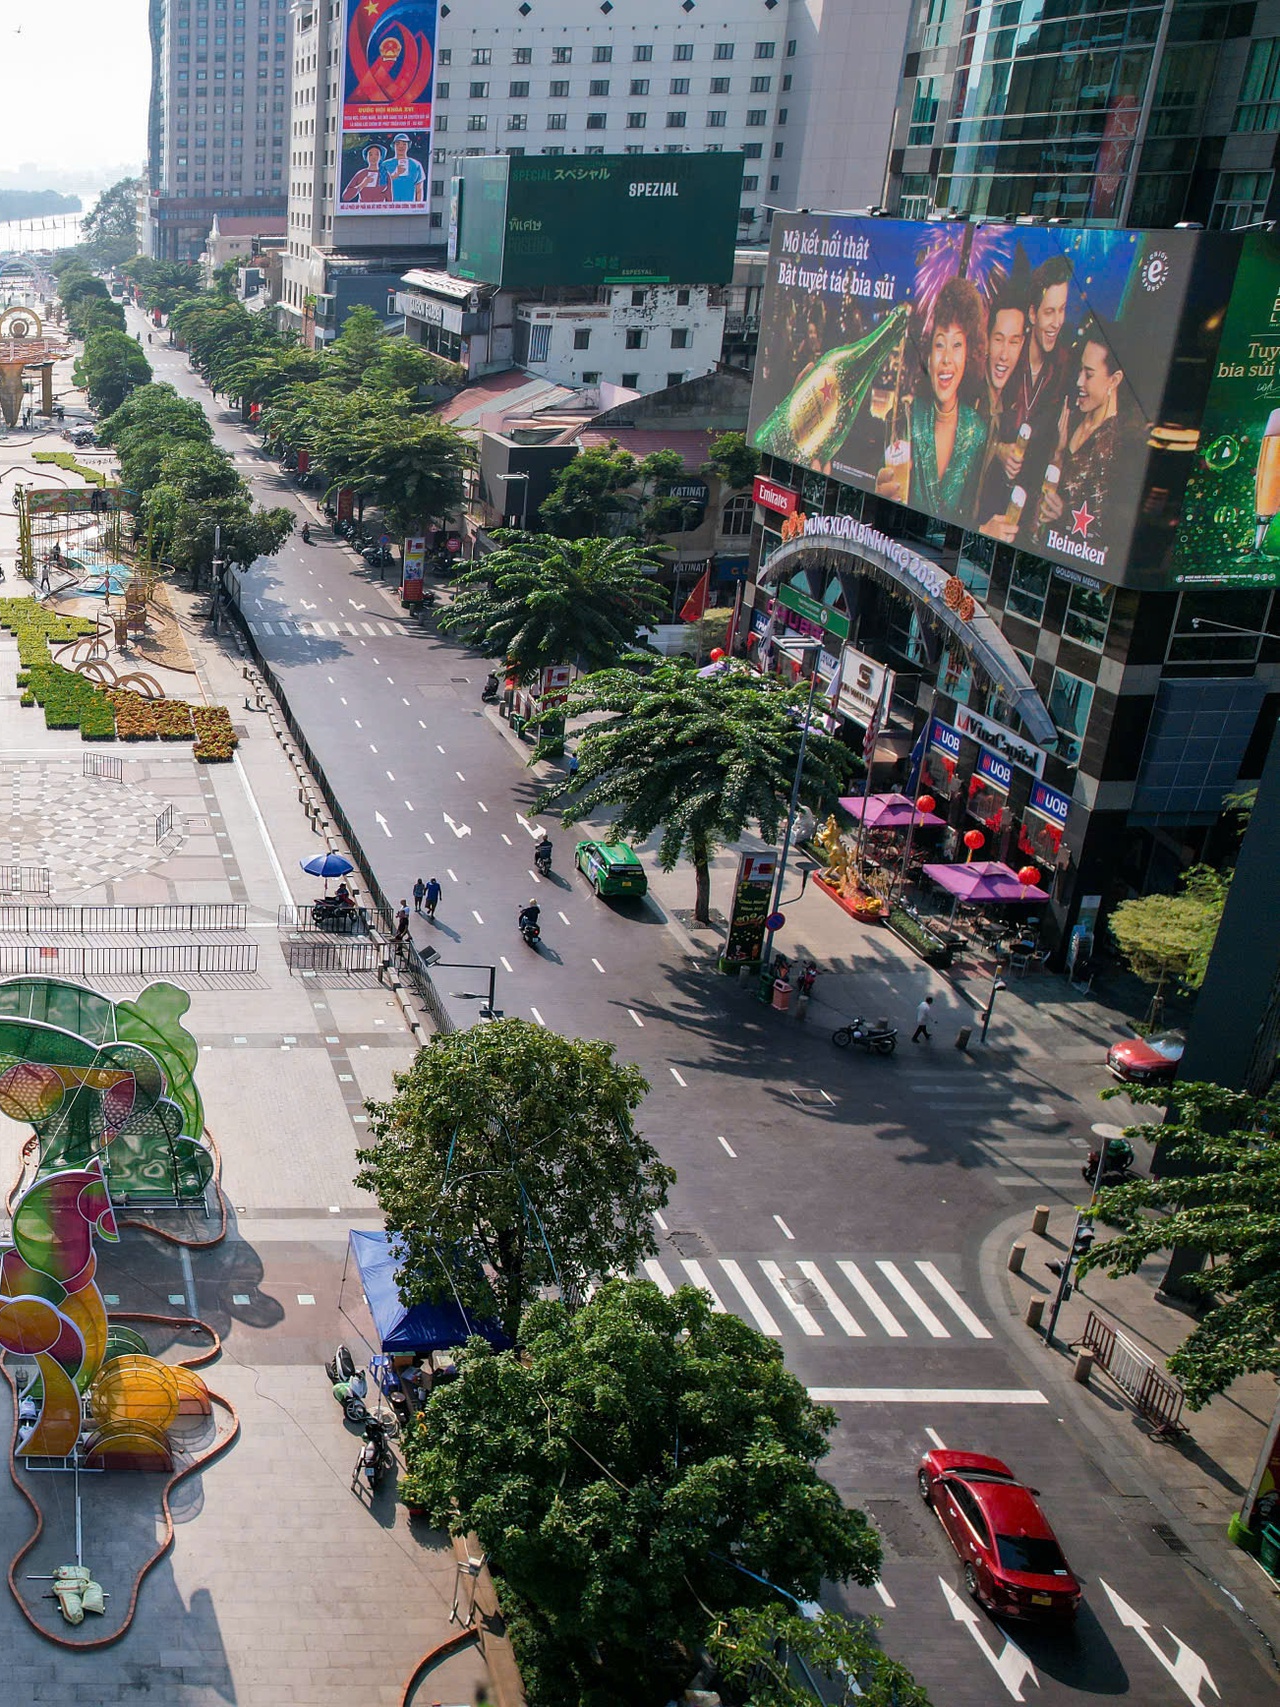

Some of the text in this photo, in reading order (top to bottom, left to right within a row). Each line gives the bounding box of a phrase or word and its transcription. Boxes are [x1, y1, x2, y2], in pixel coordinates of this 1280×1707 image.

[554, 168, 610, 180] スペシャル
[628, 182, 679, 197] SPEZIAL
[782, 228, 870, 266] Mở kết nối thật
[778, 262, 896, 300] Bật tuyệt tác bia sủi
[1248, 342, 1280, 361] Tuy
[1217, 360, 1276, 378] bia sủi
[670, 486, 707, 498] KATINAT
[759, 484, 788, 510] Emirates
[804, 512, 829, 536] MỪNG
[829, 515, 857, 540] XUÂN
[858, 522, 884, 552] BÍNH
[909, 557, 941, 598] 2026
[1046, 530, 1105, 566] Heineken
[673, 563, 706, 573] KATINAT
[1056, 566, 1100, 590] GOLDSUN MEDIA
[942, 730, 960, 750] UOB
[970, 716, 1038, 772] VinaCapital
[990, 763, 1010, 786] UOB
[1045, 794, 1068, 818] UOB
